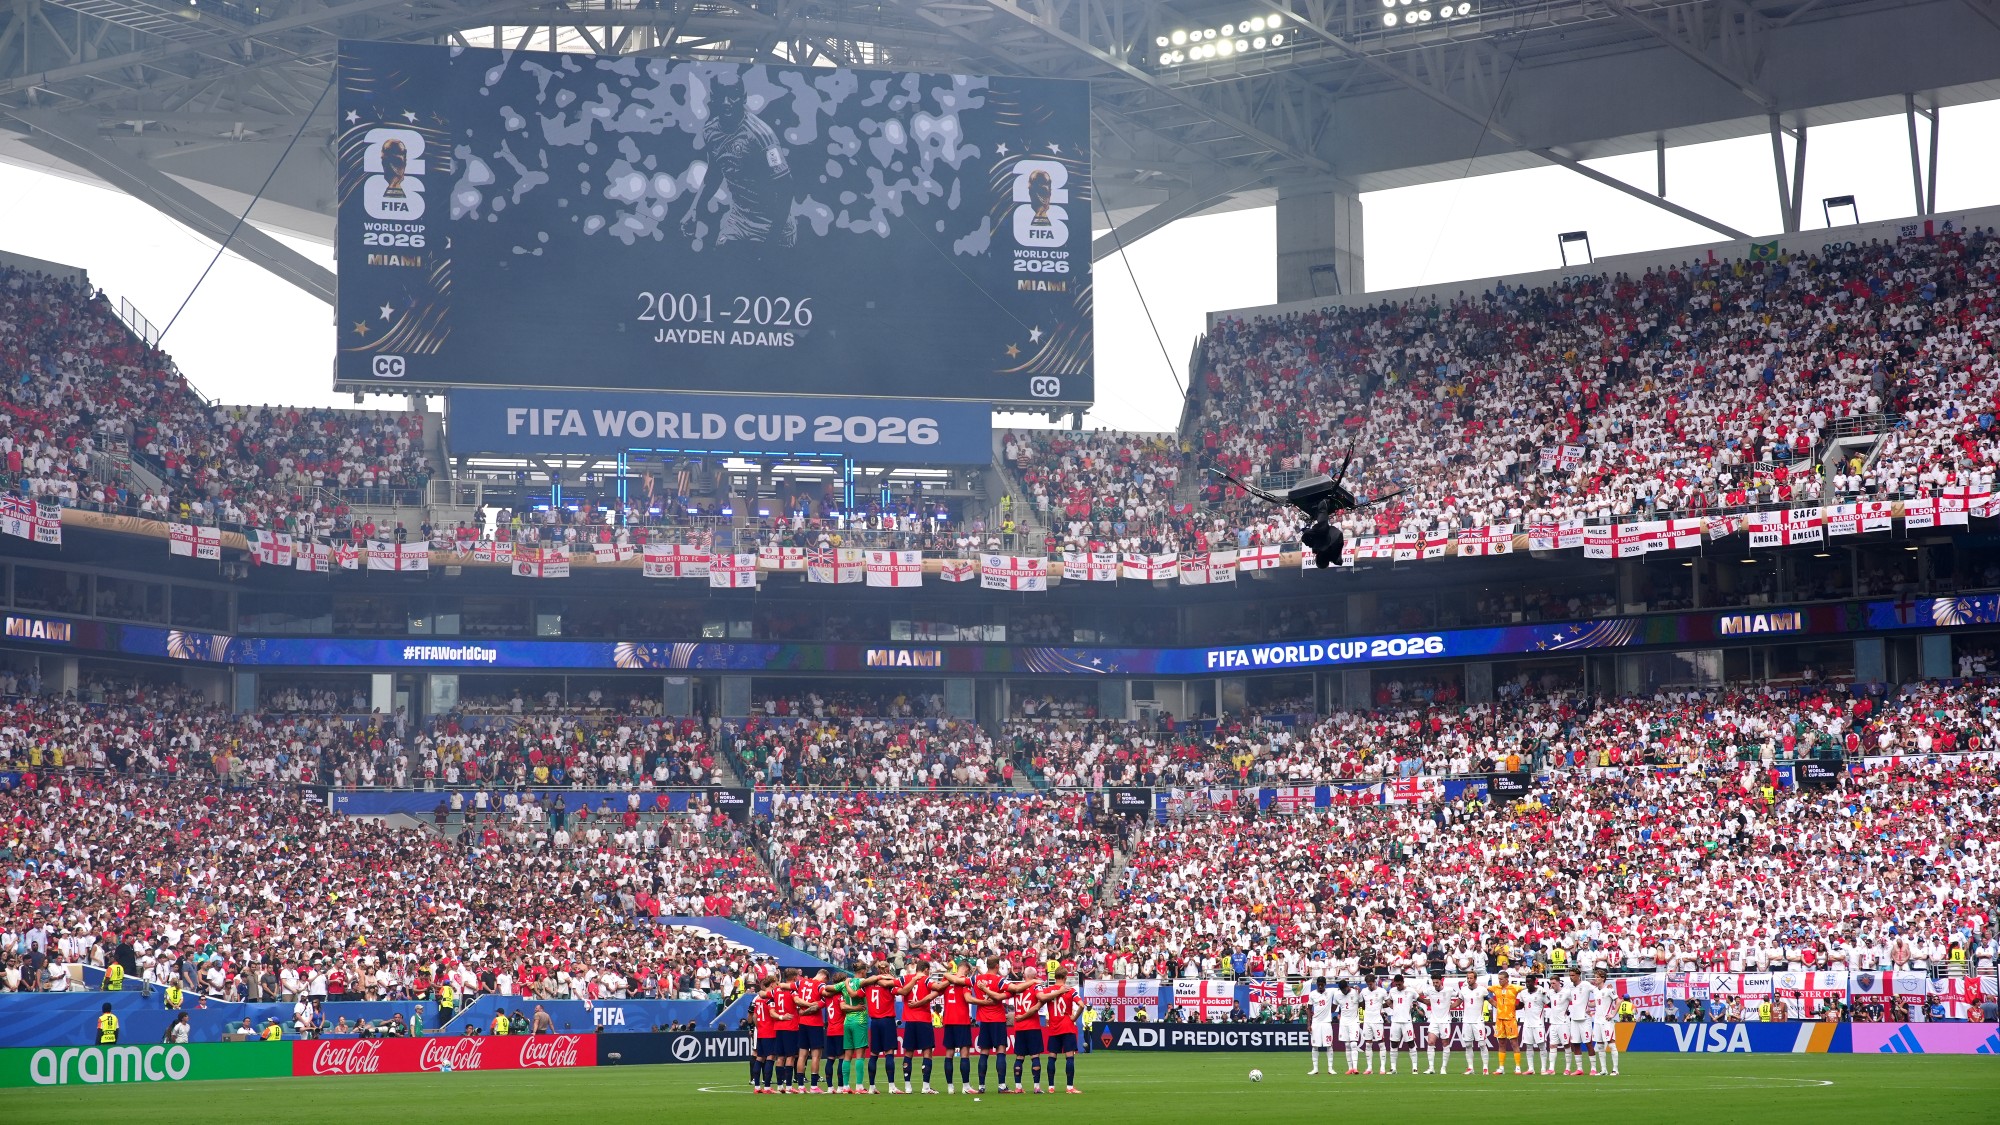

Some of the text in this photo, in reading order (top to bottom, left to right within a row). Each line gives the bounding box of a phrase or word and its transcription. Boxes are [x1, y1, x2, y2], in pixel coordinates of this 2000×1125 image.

[382, 201, 408, 212] FIFA
[364, 223, 425, 232] WORLD CUP
[364, 233, 425, 247] 2026
[1029, 230, 1054, 240] FIFA
[368, 254, 421, 267] MIAMI
[1014, 250, 1069, 259] WORLD CUP
[1014, 260, 1069, 273] 2026
[1018, 280, 1066, 292] MIAMI
[637, 292, 813, 326] 2001-2026
[655, 329, 795, 347] JAYDEN ADAMS
[375, 358, 402, 375] CC
[1033, 380, 1057, 395] CC
[507, 407, 939, 445] FIFA WORLD CUP 2026
[1794, 508, 1817, 519] SAFC
[1832, 511, 1886, 523] BARROW AFC
[1910, 507, 1936, 515] ILSON
[1656, 530, 1686, 538] RAUNDS
[1762, 522, 1809, 532] DURHAM
[1458, 536, 1491, 544] FORDHOUSES
[1589, 537, 1619, 545] RUNNING
[1753, 535, 1778, 544] AMBER
[1792, 530, 1820, 541] AMELIA
[983, 567, 1034, 577] PORTSMOUTH
[5, 617, 72, 642] MIAMI
[1721, 611, 1802, 635] MIAMI
[403, 645, 497, 663] #FIFAWorldCup
[867, 649, 942, 667] MIAMI
[1207, 637, 1443, 668] FIFA WORLD CUP 2026
[777, 993, 785, 1013] 5
[871, 989, 879, 1009] 9
[1086, 996, 1156, 1006] MIDDLESBROUGH
[1175, 997, 1232, 1006] Jimmy Lockett
[1318, 999, 1326, 1007] 20
[827, 1000, 835, 1019] 6
[1052, 996, 1067, 1017] 10
[593, 1007, 626, 1026] FIFA
[1117, 1028, 1310, 1046] ADI PREDICTSTREE
[1665, 1023, 1752, 1053] VISA
[519, 1035, 580, 1067] Coca-Cola
[705, 1037, 750, 1057] HYUN
[313, 1039, 384, 1074] Coca-Cola
[30, 1045, 191, 1085] aramco
